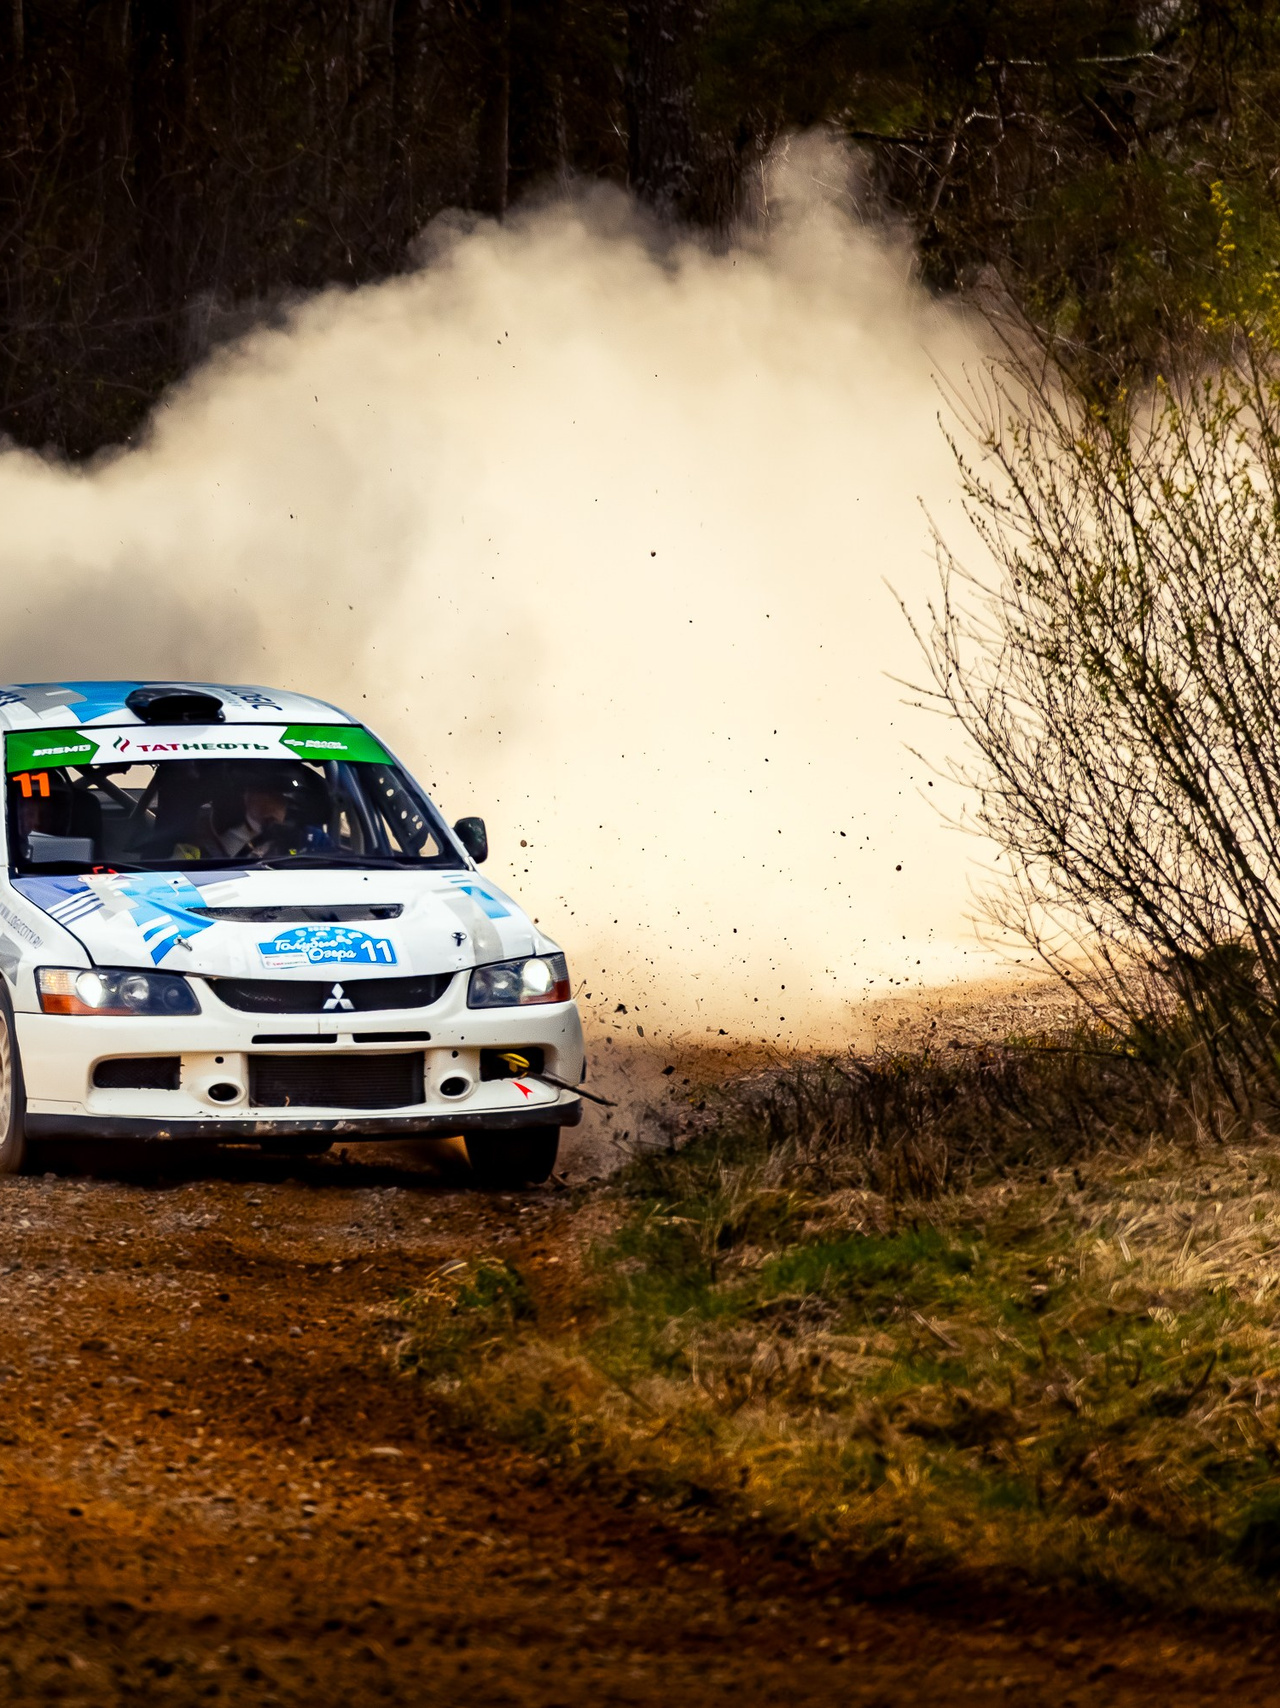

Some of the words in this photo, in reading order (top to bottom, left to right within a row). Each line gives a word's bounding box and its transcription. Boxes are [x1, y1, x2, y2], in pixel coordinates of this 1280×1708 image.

[136, 743, 269, 752] ТАТНЕФТЬ
[12, 772, 51, 797] 11
[360, 939, 394, 963] 11
